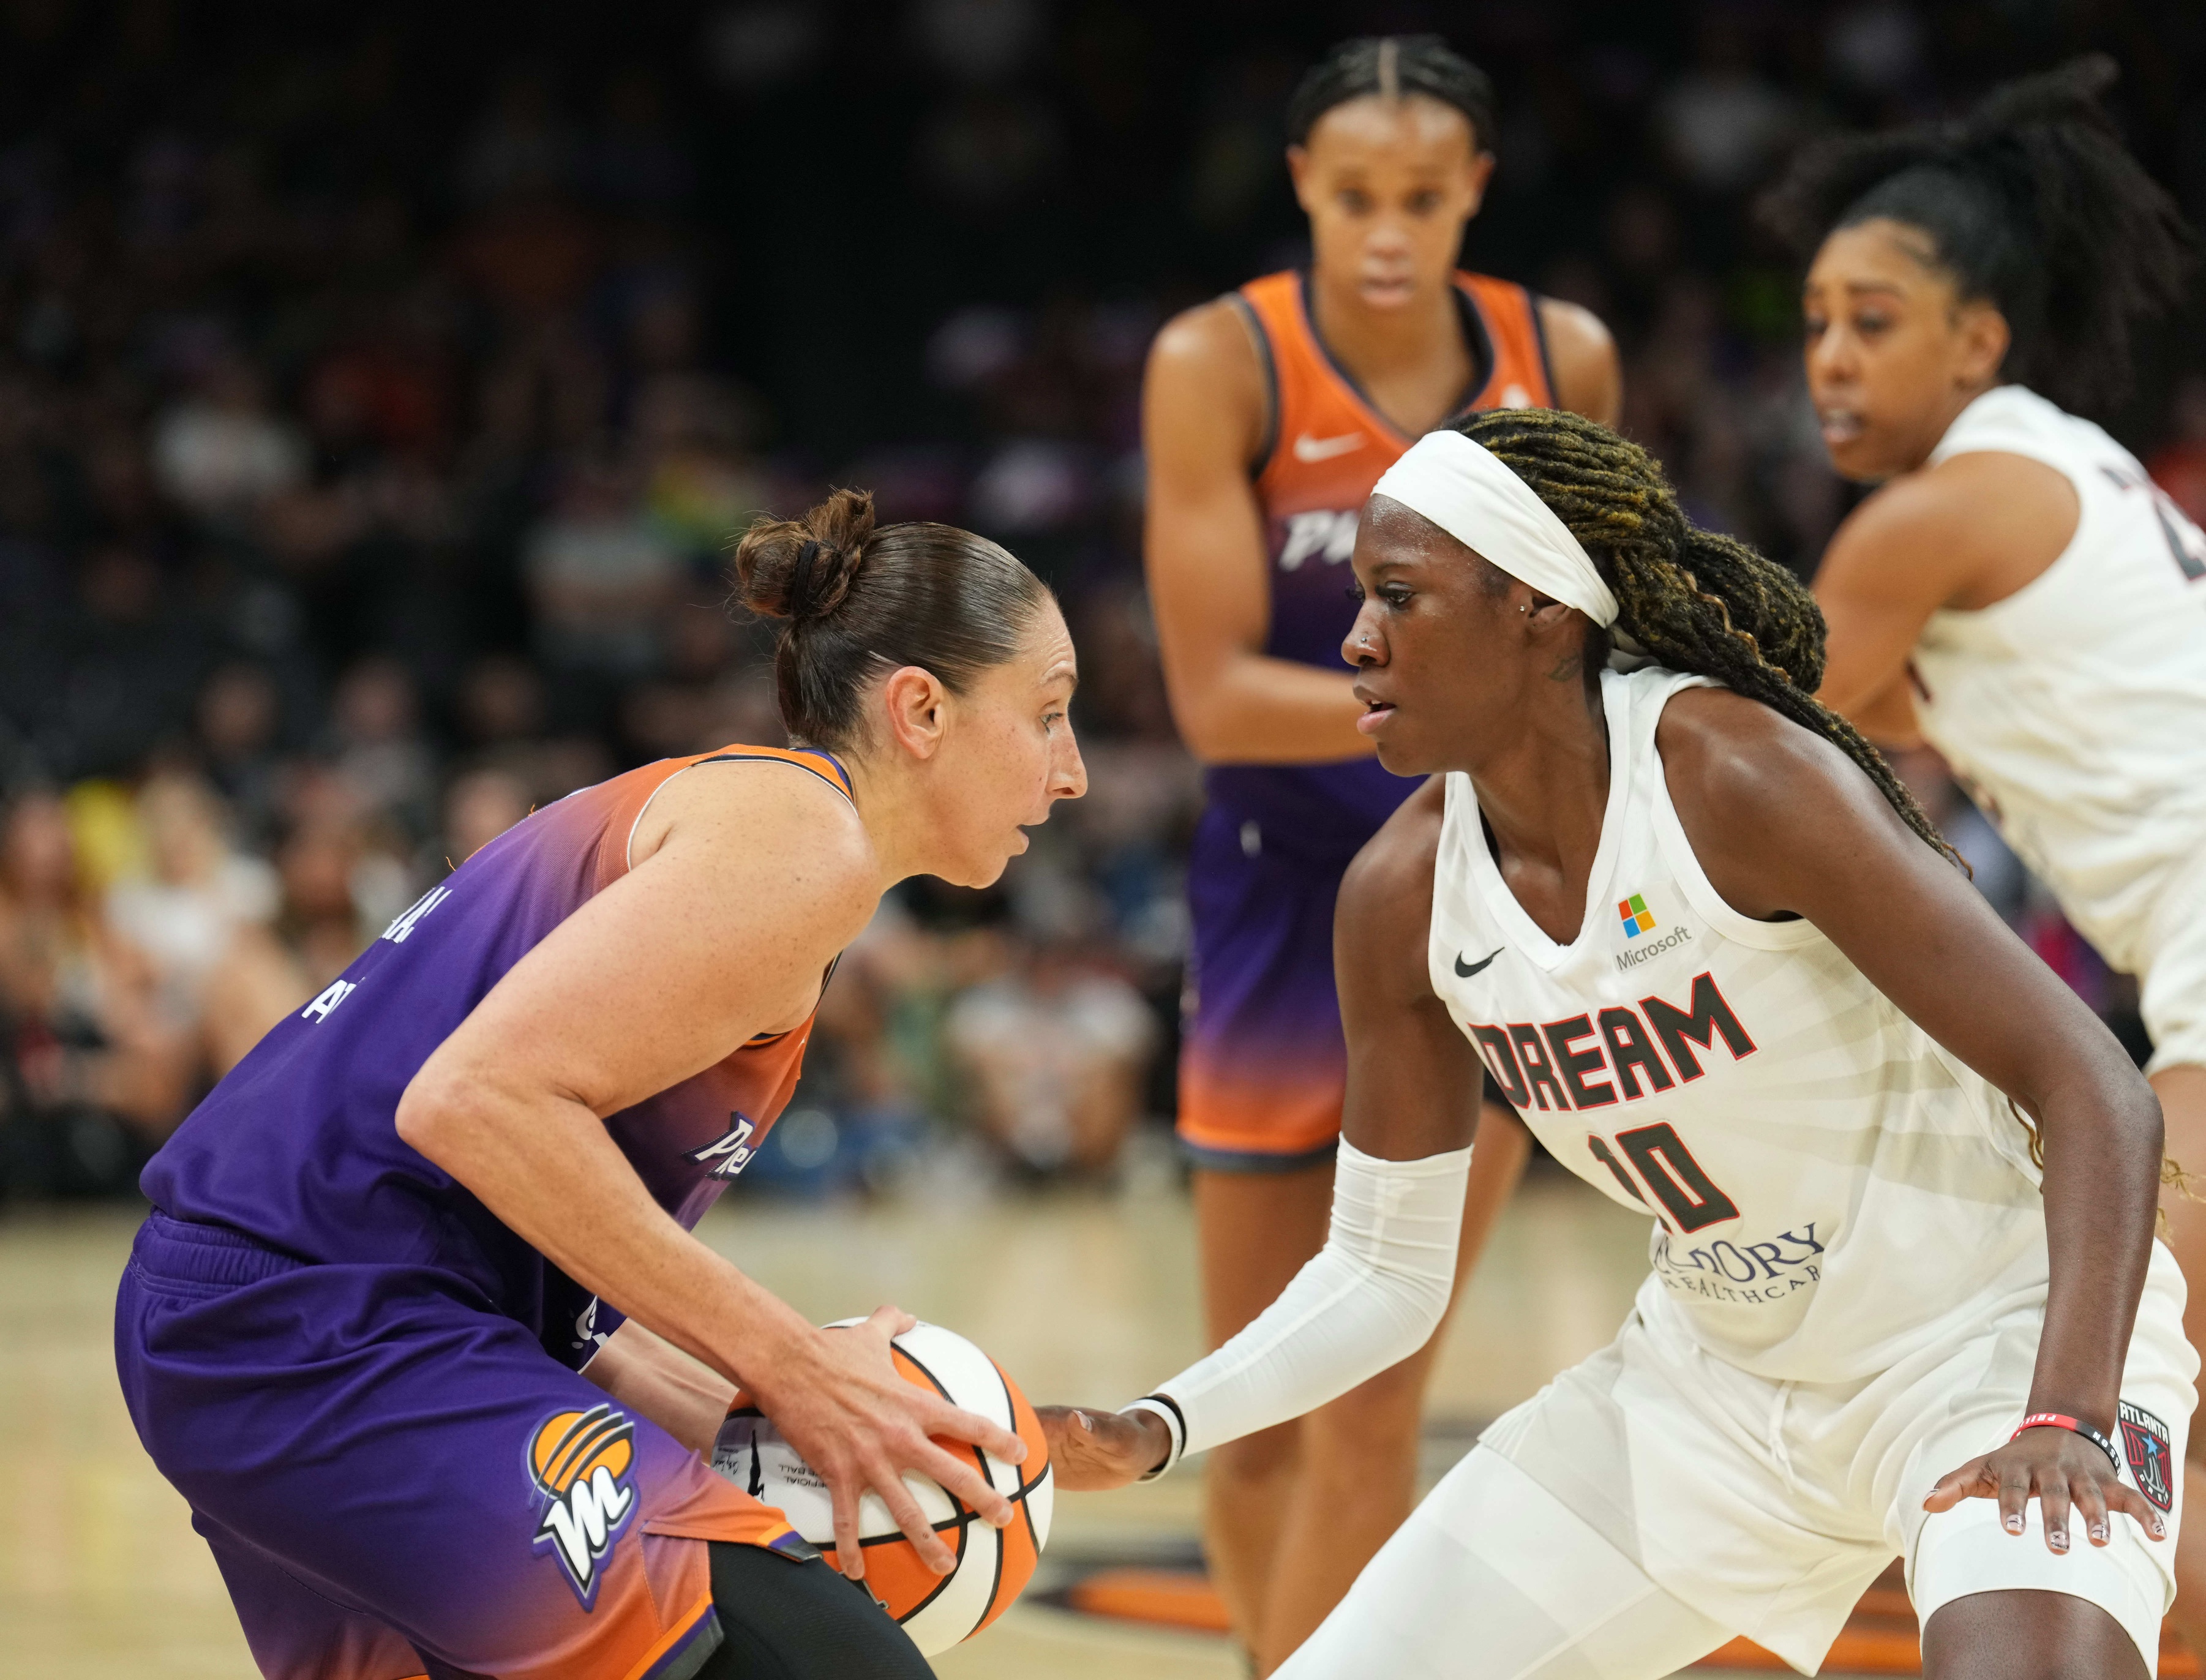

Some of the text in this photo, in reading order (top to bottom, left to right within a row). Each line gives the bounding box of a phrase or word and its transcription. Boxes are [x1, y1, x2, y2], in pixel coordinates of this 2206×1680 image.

[1616, 926, 1692, 971] Microsoft
[1467, 971, 1758, 1111] DREAM
[1588, 1122, 1740, 1235] 10
[2119, 1401, 2169, 1445] ATLANTA
